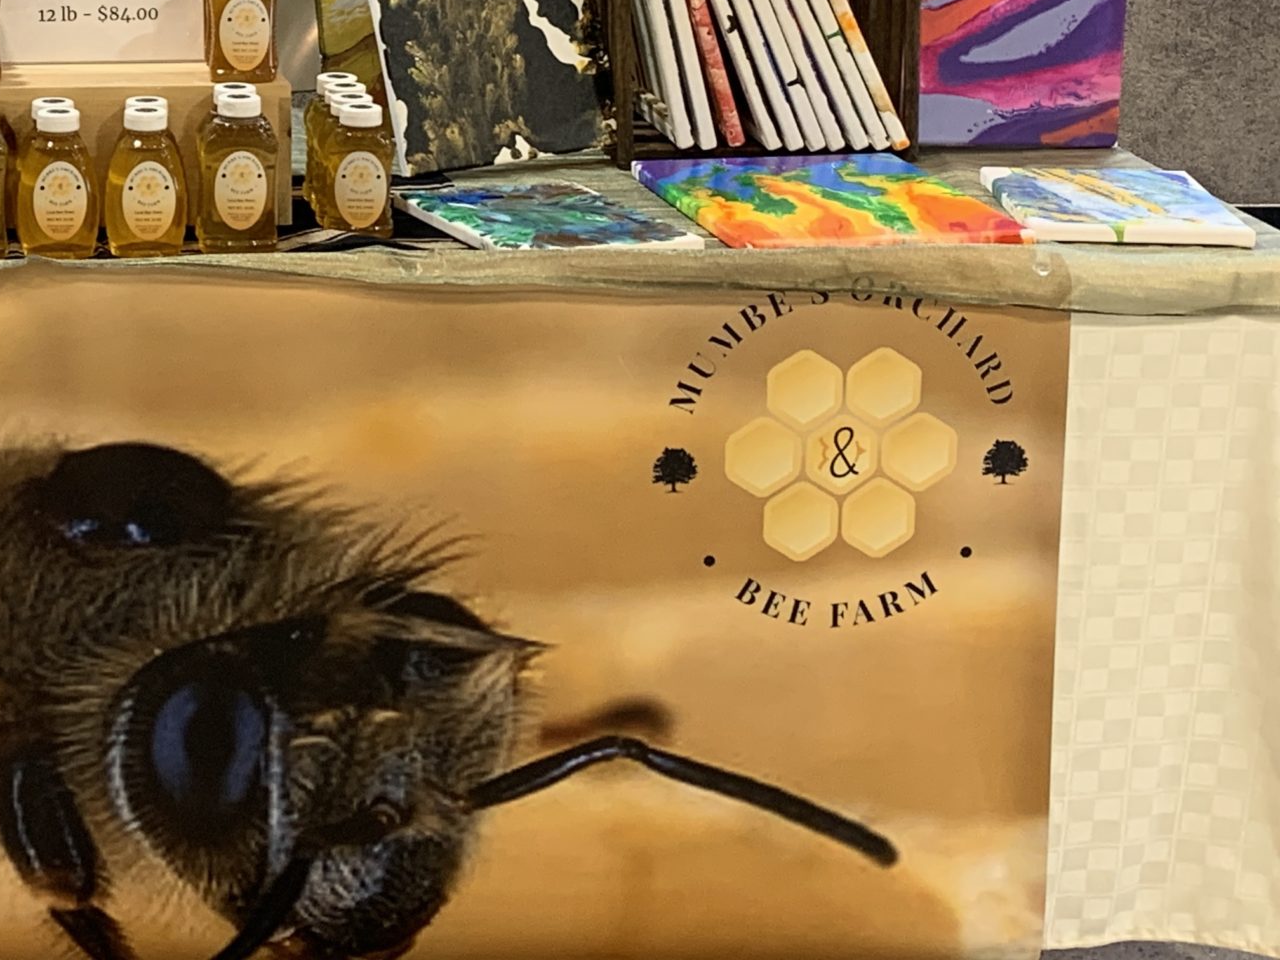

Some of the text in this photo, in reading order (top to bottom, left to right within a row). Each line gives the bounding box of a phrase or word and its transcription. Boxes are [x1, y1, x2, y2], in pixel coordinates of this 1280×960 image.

[38, 9, 57, 22] 12
[61, 5, 78, 22] lb
[97, 5, 159, 23] $84.00
[829, 426, 859, 478] &
[734, 571, 939, 628] BEE FARM
